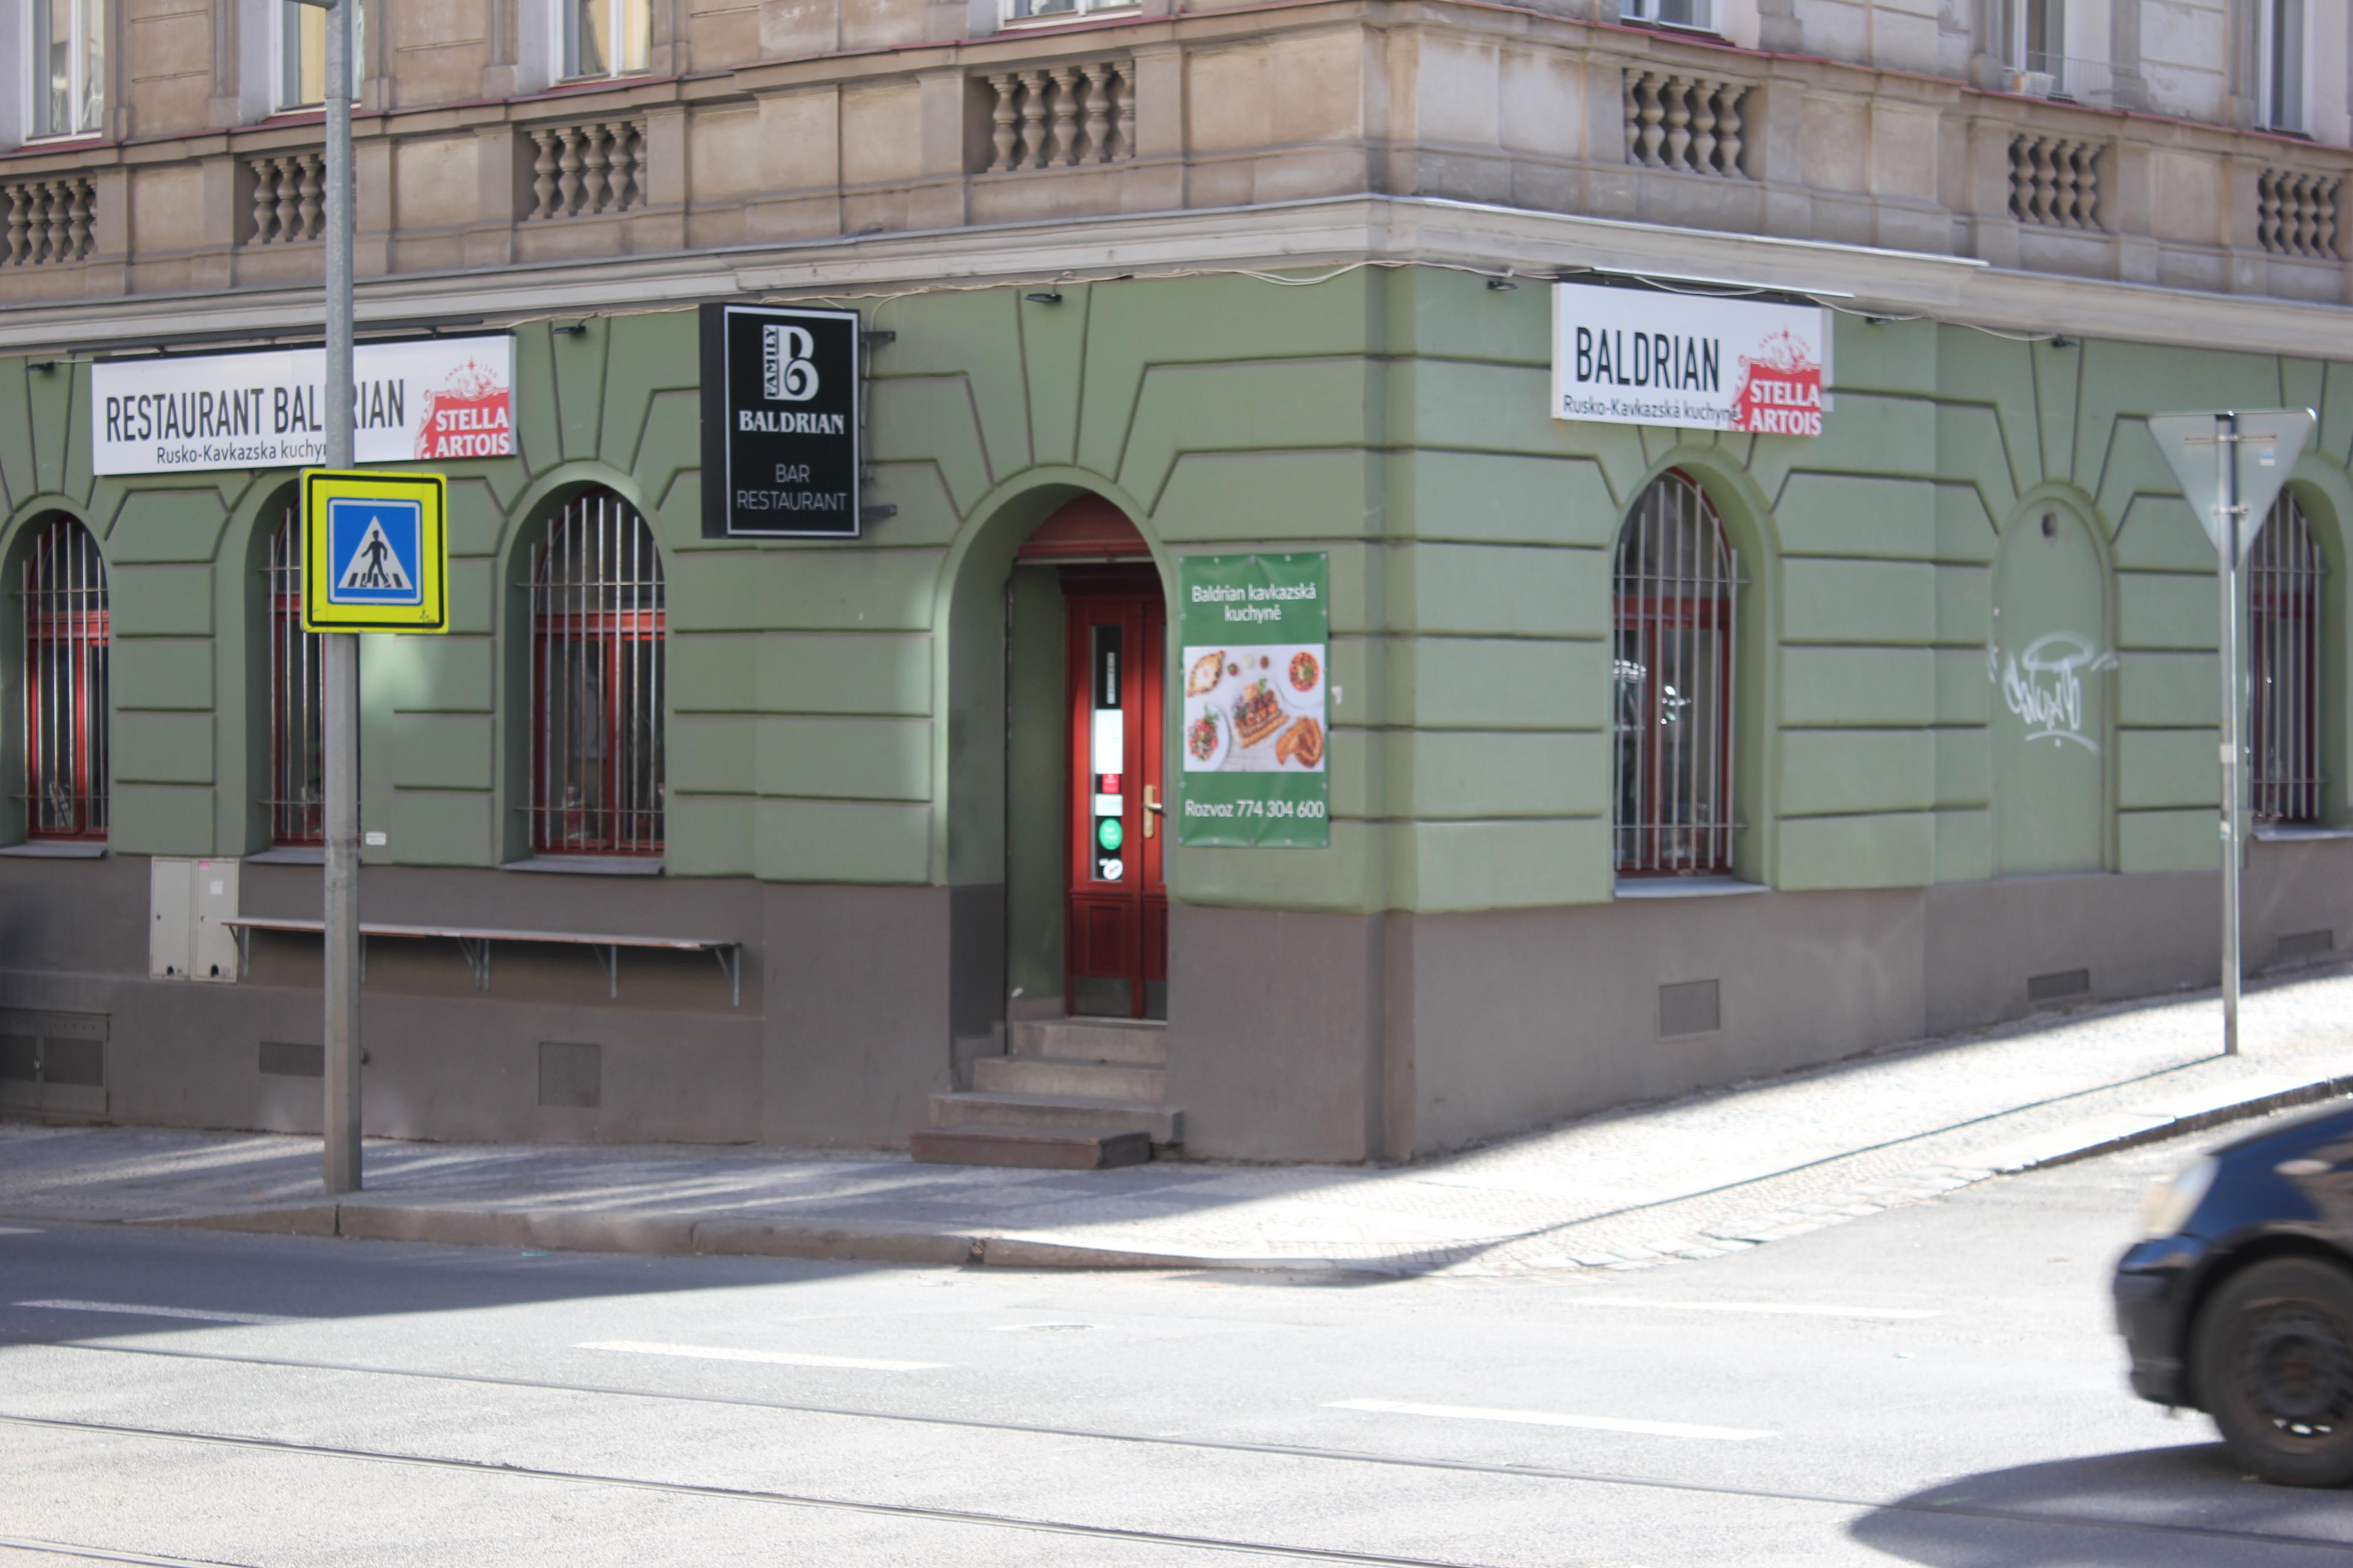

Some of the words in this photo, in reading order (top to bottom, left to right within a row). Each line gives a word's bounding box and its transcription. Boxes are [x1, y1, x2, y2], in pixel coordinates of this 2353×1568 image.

[766, 327, 779, 397] FAMILY
[1576, 326, 1719, 393] BALDRIAN
[1750, 379, 1821, 408] STELLA
[106, 388, 264, 443] RESTAURANT
[274, 379, 405, 435] BALIAN
[435, 406, 509, 432] STELLA
[739, 410, 845, 435] BALDRIAN
[1684, 400, 1739, 427] kuchyně
[1749, 407, 1822, 435] ARTOIS
[157, 441, 276, 465] Rusko-Kavkazska
[281, 439, 326, 463] kuchy
[434, 432, 510, 458] ARTOIS
[776, 463, 810, 484] BAR
[737, 490, 848, 512] RESTAURANT
[1191, 585, 1246, 603] Baldrian
[1248, 582, 1317, 600] kavkazská
[1224, 604, 1282, 625] kuchyně
[1185, 799, 1234, 818] Rozvoz
[1236, 799, 1264, 818] 774
[1266, 800, 1294, 818] 304
[1297, 800, 1325, 818] 600
